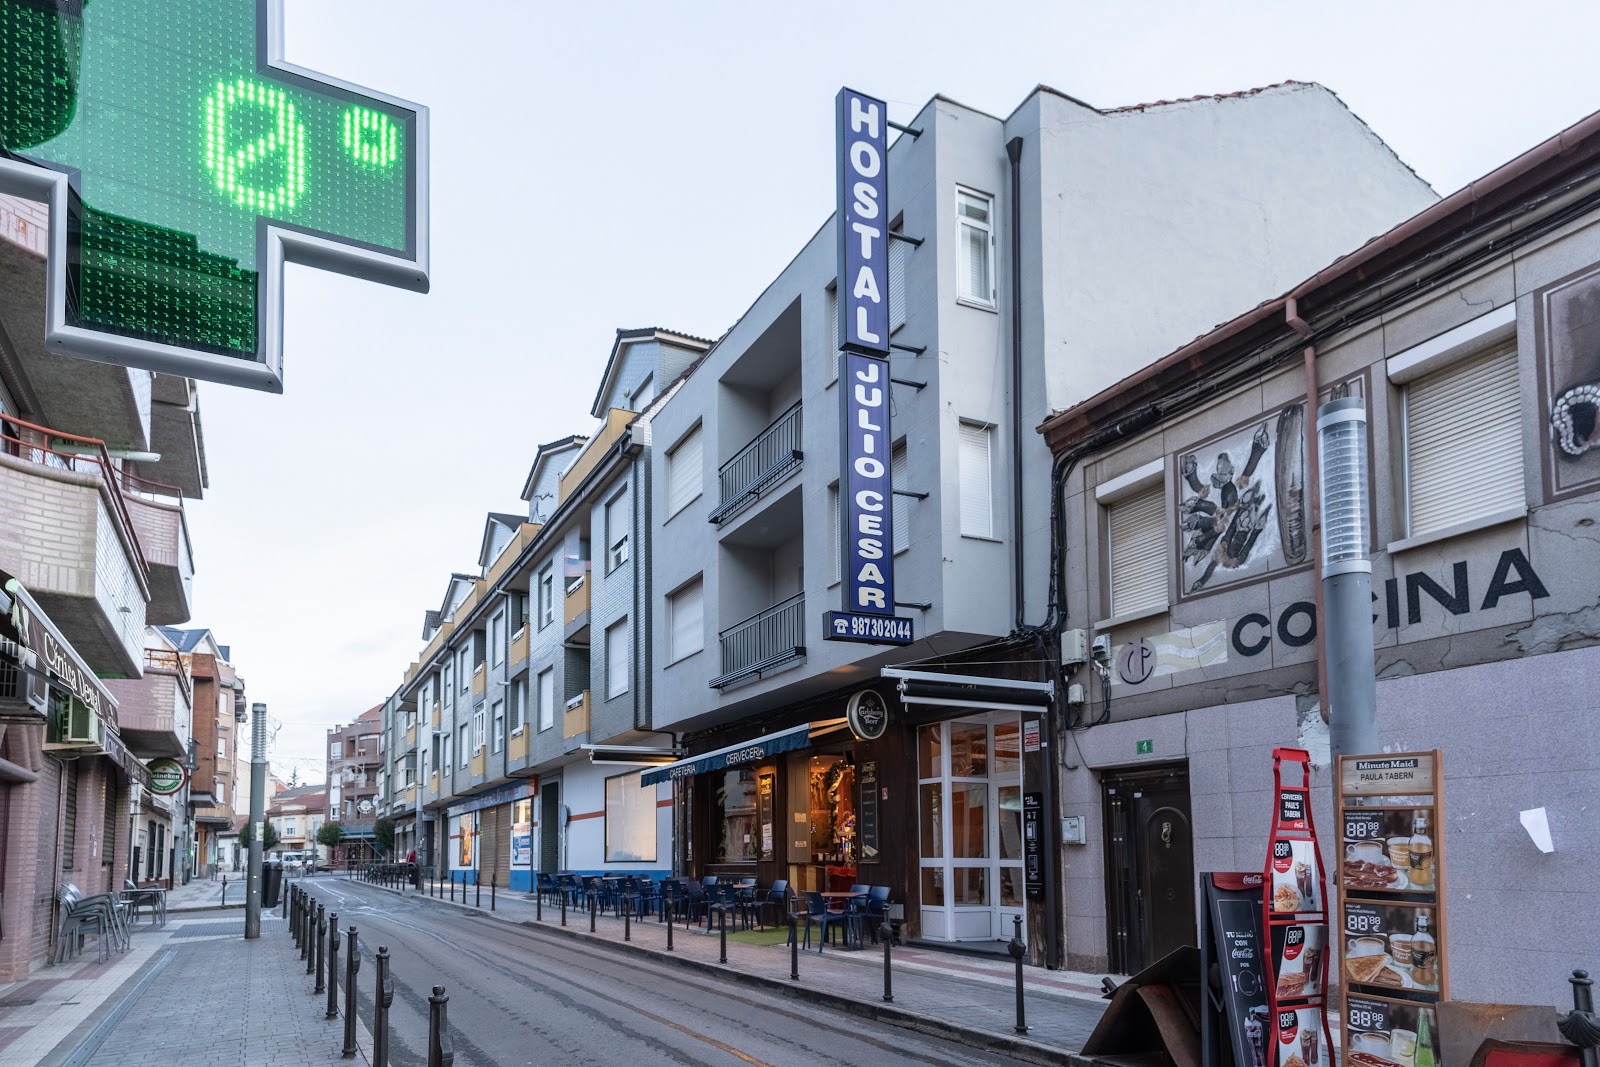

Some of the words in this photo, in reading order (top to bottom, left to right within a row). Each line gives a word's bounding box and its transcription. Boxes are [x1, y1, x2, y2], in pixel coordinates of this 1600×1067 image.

[850, 97, 881, 344] HOSTAL
[854, 363, 885, 479] JULIO
[855, 490, 886, 609] CESAR
[1231, 547, 1550, 657] COINA
[852, 616, 911, 639] 987302044
[859, 706, 883, 718] Carlsberg
[1142, 741, 1148, 752] 4
[1358, 762, 1390, 770] Minute
[1391, 760, 1414, 768] Maid
[151, 772, 180, 780] eineken
[669, 765, 696, 779] CAFETERIA
[1360, 773, 1384, 781] PAULA
[1385, 772, 1414, 780] TABERN
[1284, 810, 1301, 818] TABERN
